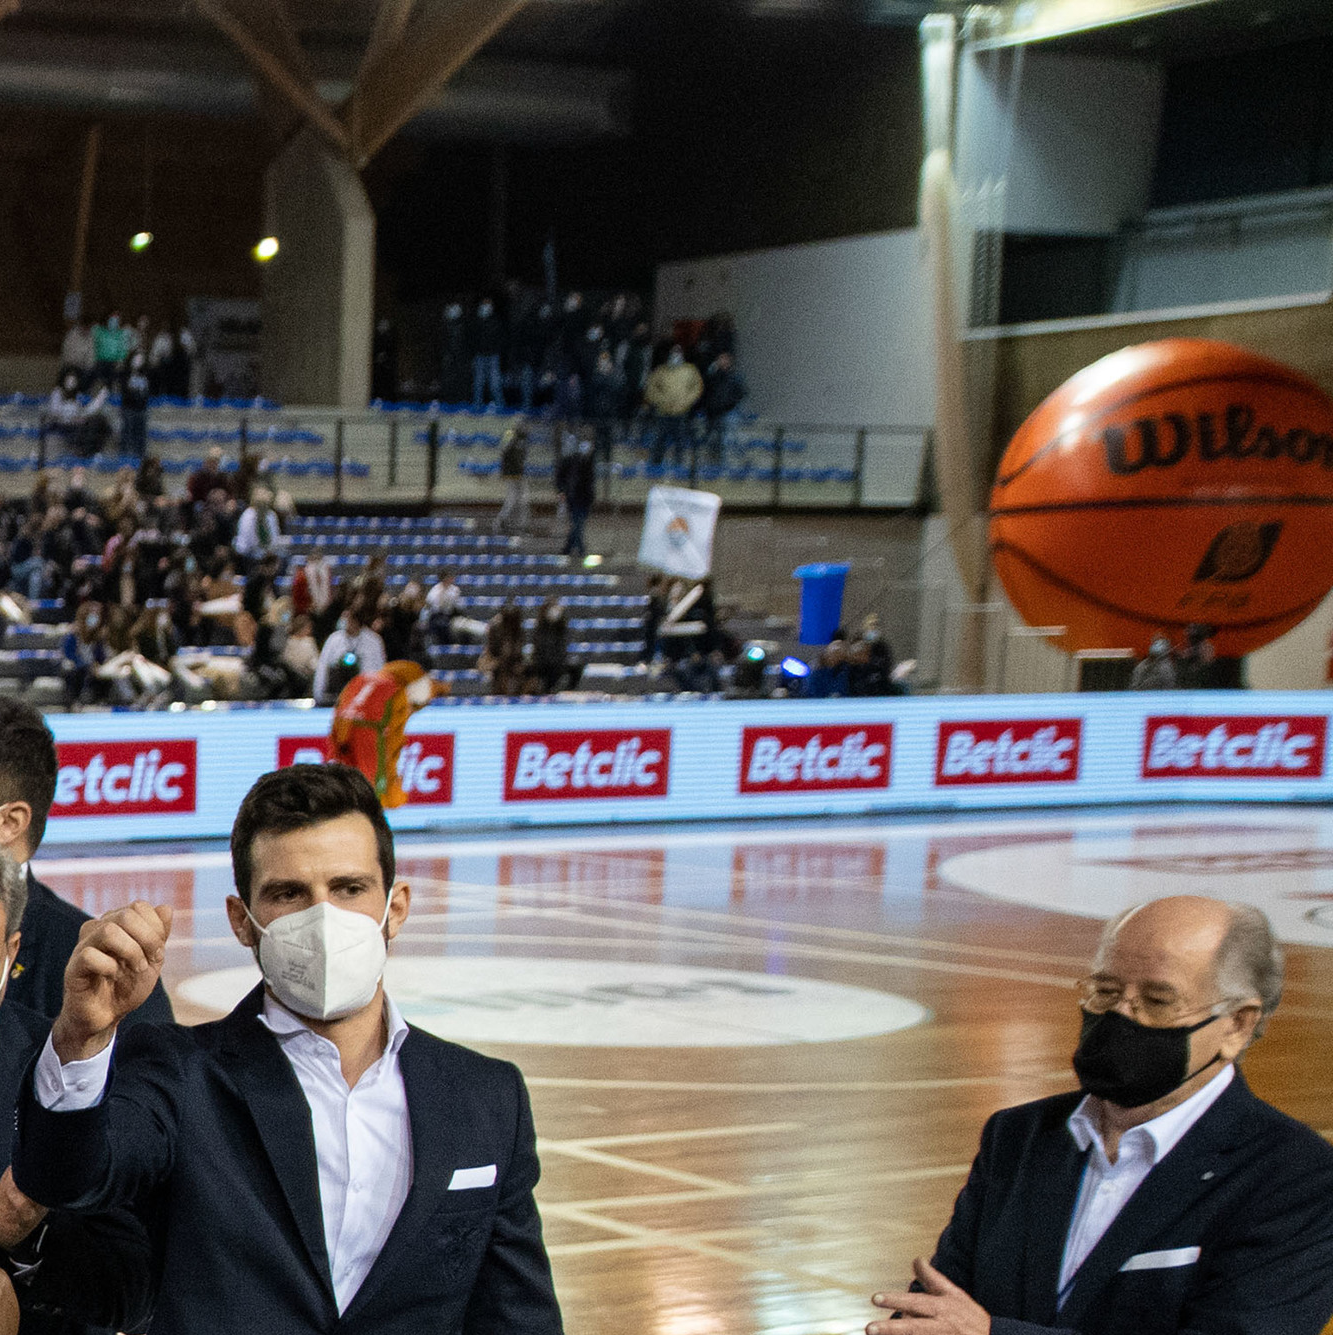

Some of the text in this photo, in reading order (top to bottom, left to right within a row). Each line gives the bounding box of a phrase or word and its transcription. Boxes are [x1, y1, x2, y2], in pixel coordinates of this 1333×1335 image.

[512, 736, 663, 791] Betclic
[745, 730, 887, 783] Betclic
[941, 725, 1076, 778] Betclic
[1147, 721, 1317, 770] Betclic
[54, 748, 188, 806] etclic
